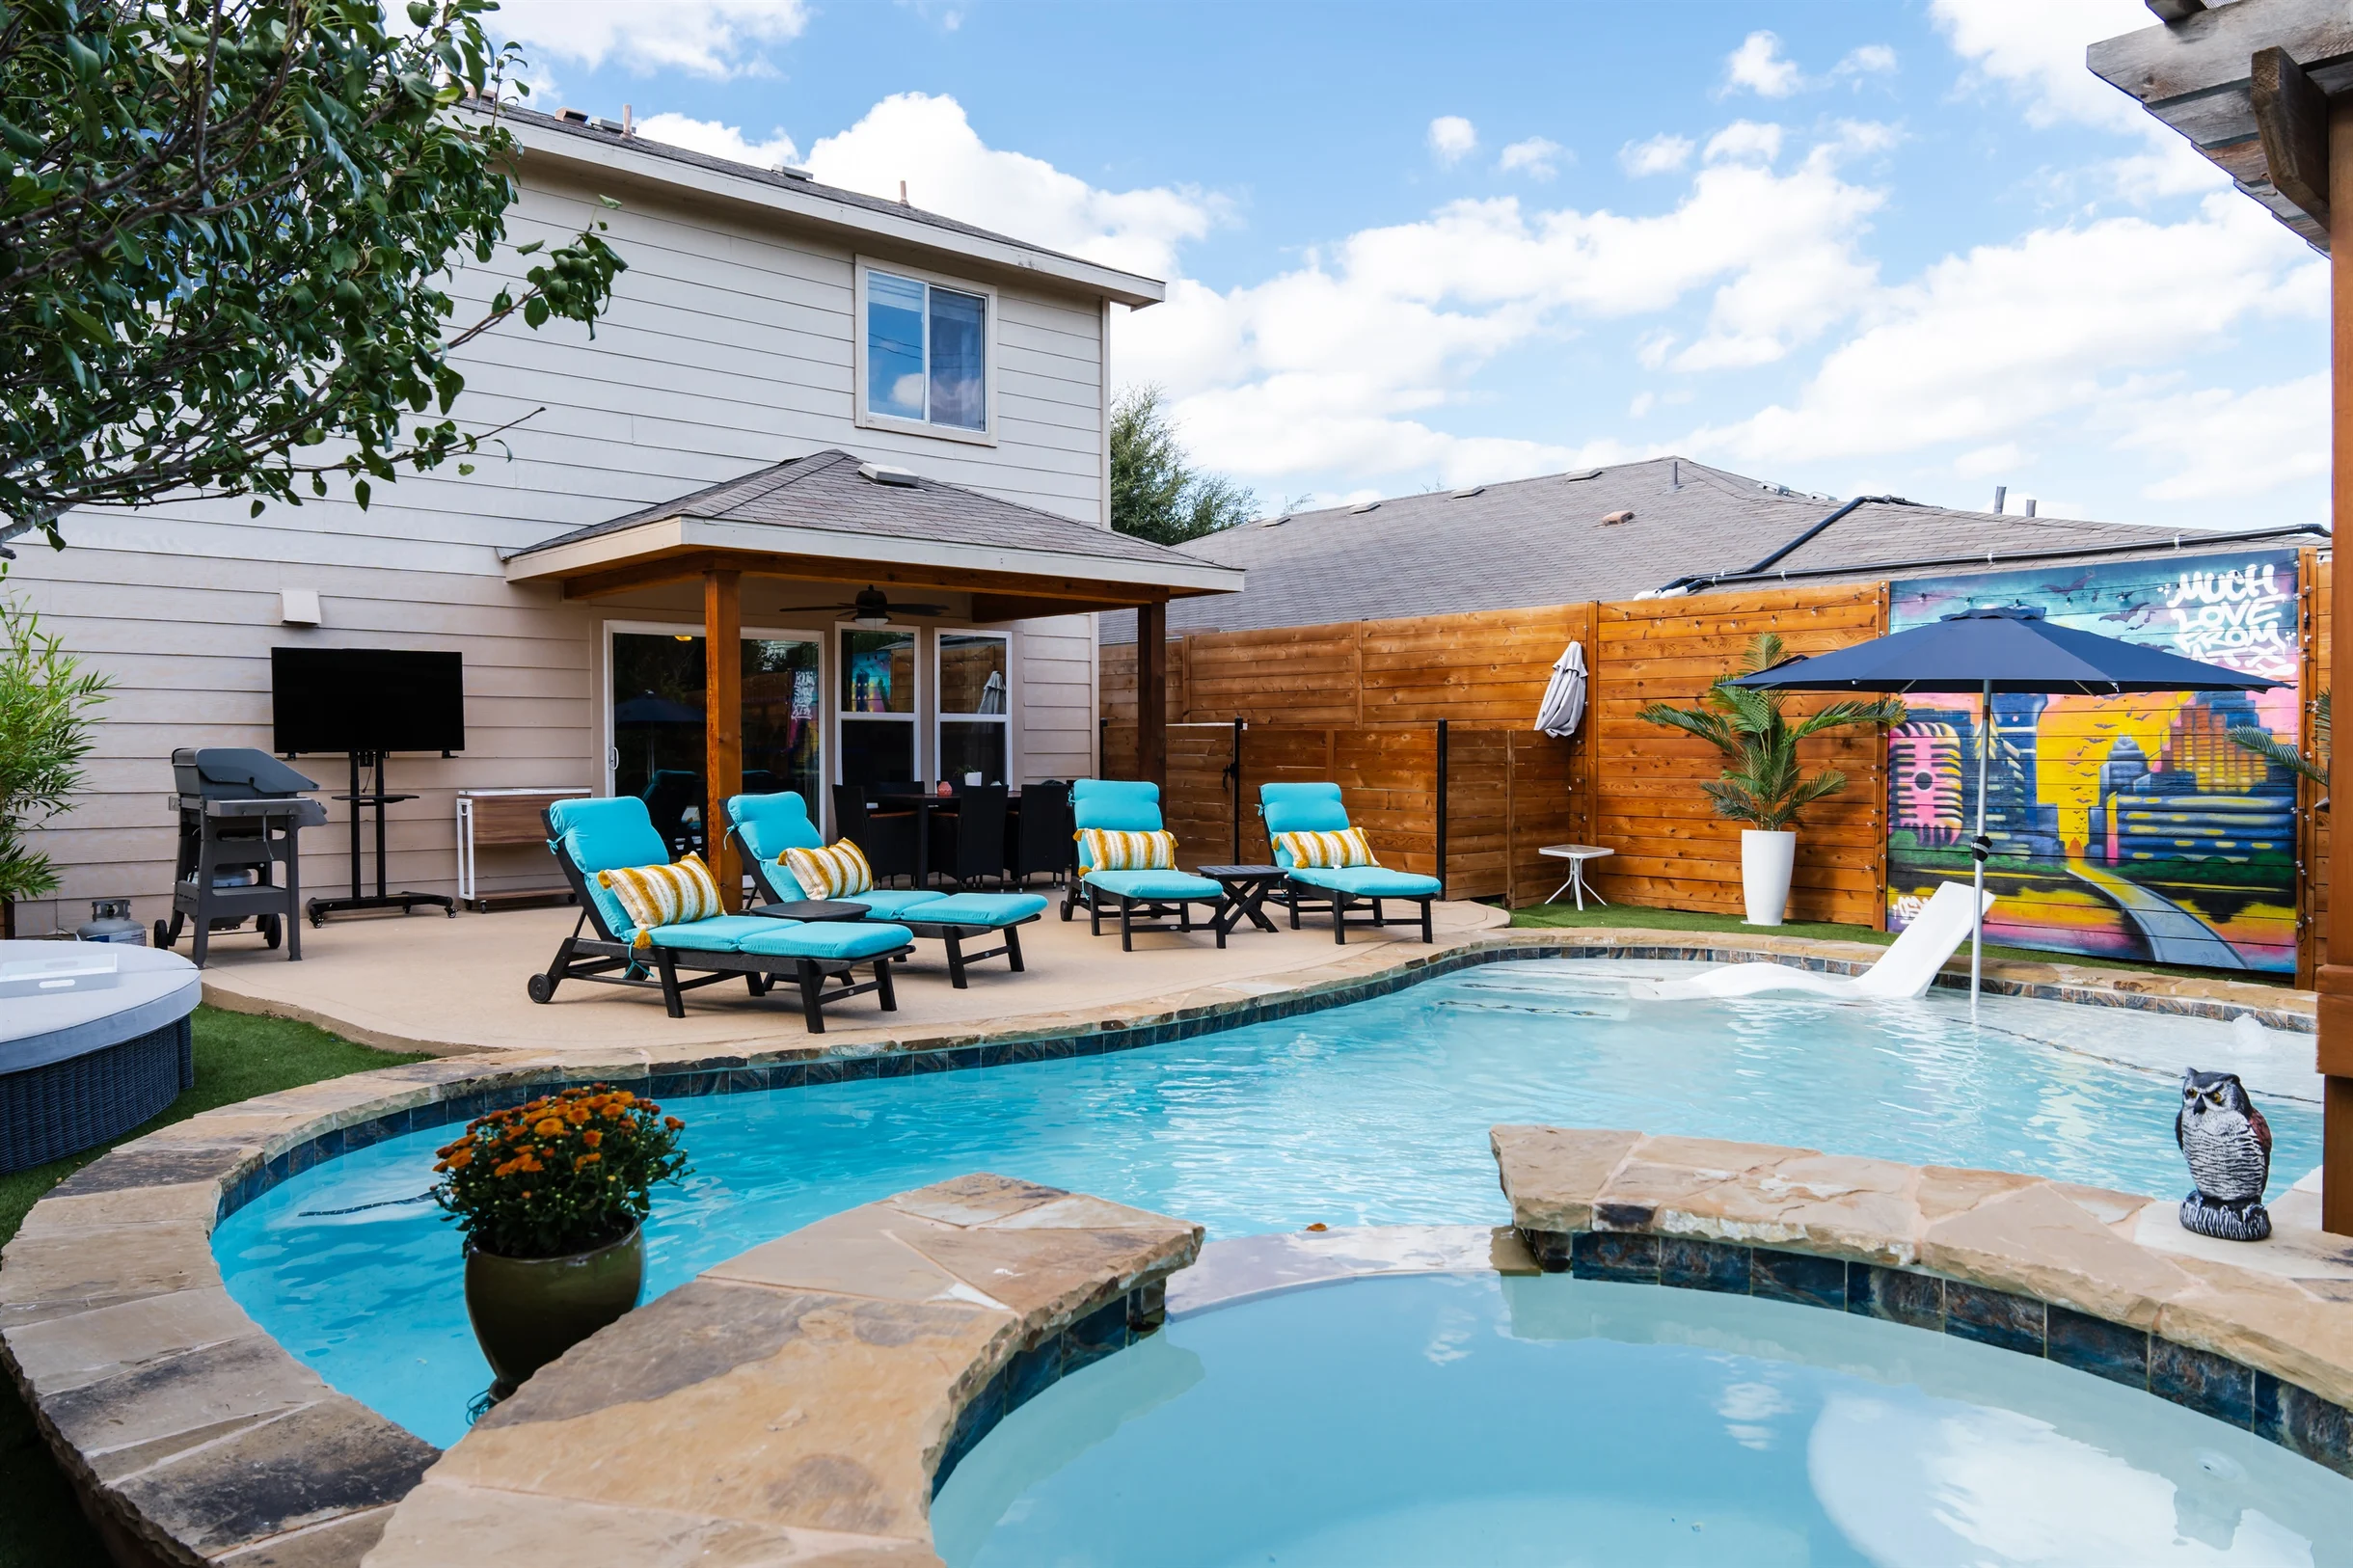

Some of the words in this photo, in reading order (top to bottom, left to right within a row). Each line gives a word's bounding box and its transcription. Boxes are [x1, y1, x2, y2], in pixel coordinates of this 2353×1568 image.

[2166, 563, 2279, 608] MUCH
[2170, 593, 2287, 628] LOVE
[2174, 621, 2286, 656] FROM
